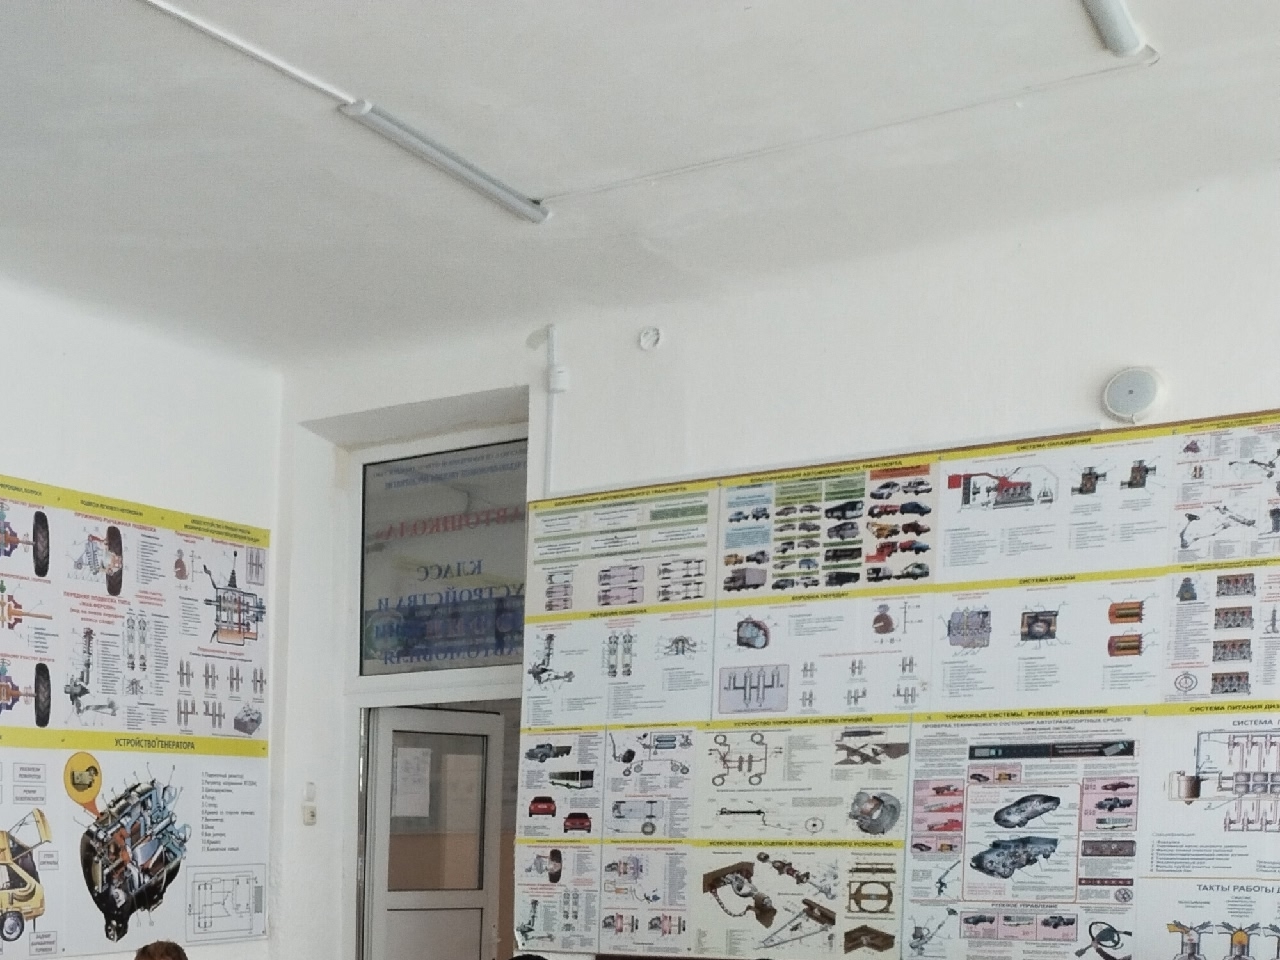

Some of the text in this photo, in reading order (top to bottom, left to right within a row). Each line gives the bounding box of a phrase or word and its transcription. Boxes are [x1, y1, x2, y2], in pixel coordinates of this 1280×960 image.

[1019, 577, 1049, 585] СИСТЕМА
[1027, 709, 1060, 717] РУЛЕВОЕ
[1061, 708, 1108, 716] УПРАВЛЕНИЕ
[1232, 719, 1273, 727] СИСТЕМА
[114, 737, 195, 750] УСТРОЙСТВО ГЕНЕРАТОРА
[1196, 884, 1274, 893] ТАКТЫ РАБОТЫ
